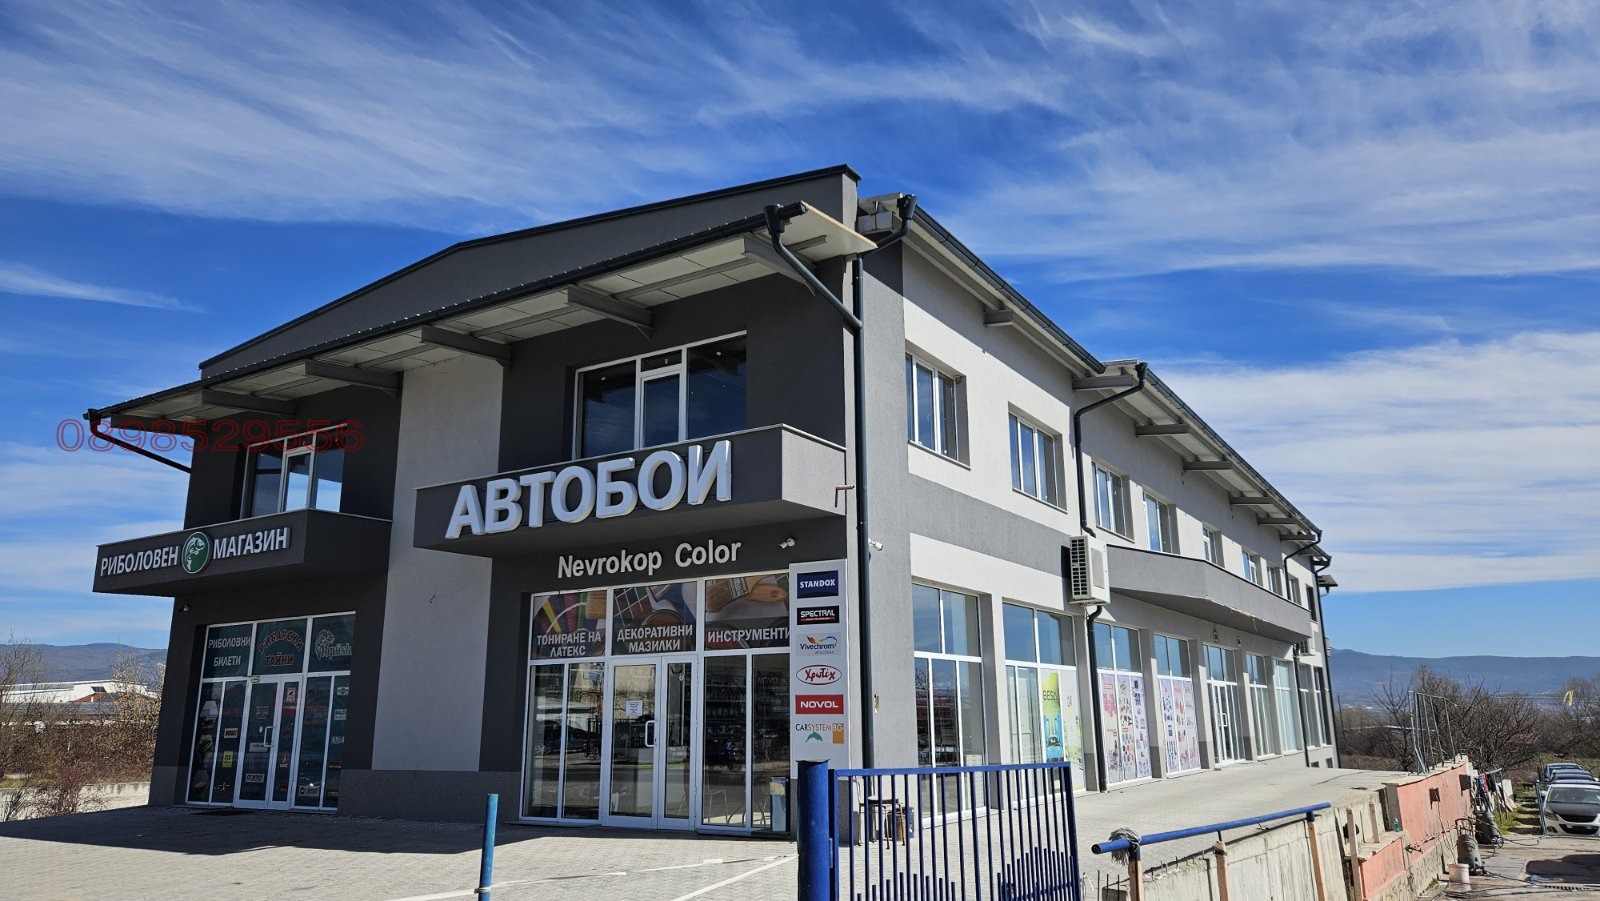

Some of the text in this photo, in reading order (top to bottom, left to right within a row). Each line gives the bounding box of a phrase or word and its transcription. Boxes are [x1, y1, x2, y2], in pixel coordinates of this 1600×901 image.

[444, 440, 732, 539] АВТОБОИ
[100, 527, 291, 577] РИБОЛОВЕН МАГАЗИН
[557, 540, 742, 578] Nevrokop Color
[800, 579, 835, 589] STANDOX
[800, 610, 835, 618] SPECTRAL
[536, 631, 601, 646] ТОНИРАНЕ НА
[617, 624, 693, 642] ДЕКОРАТИВНИ
[208, 636, 250, 649] РИБОЛОВНИ
[629, 639, 680, 653] МАЗИЛКИ
[549, 646, 586, 658] ЛАТЕКС
[213, 656, 241, 667] БИЛЕТИ
[800, 701, 839, 709] NOVOL
